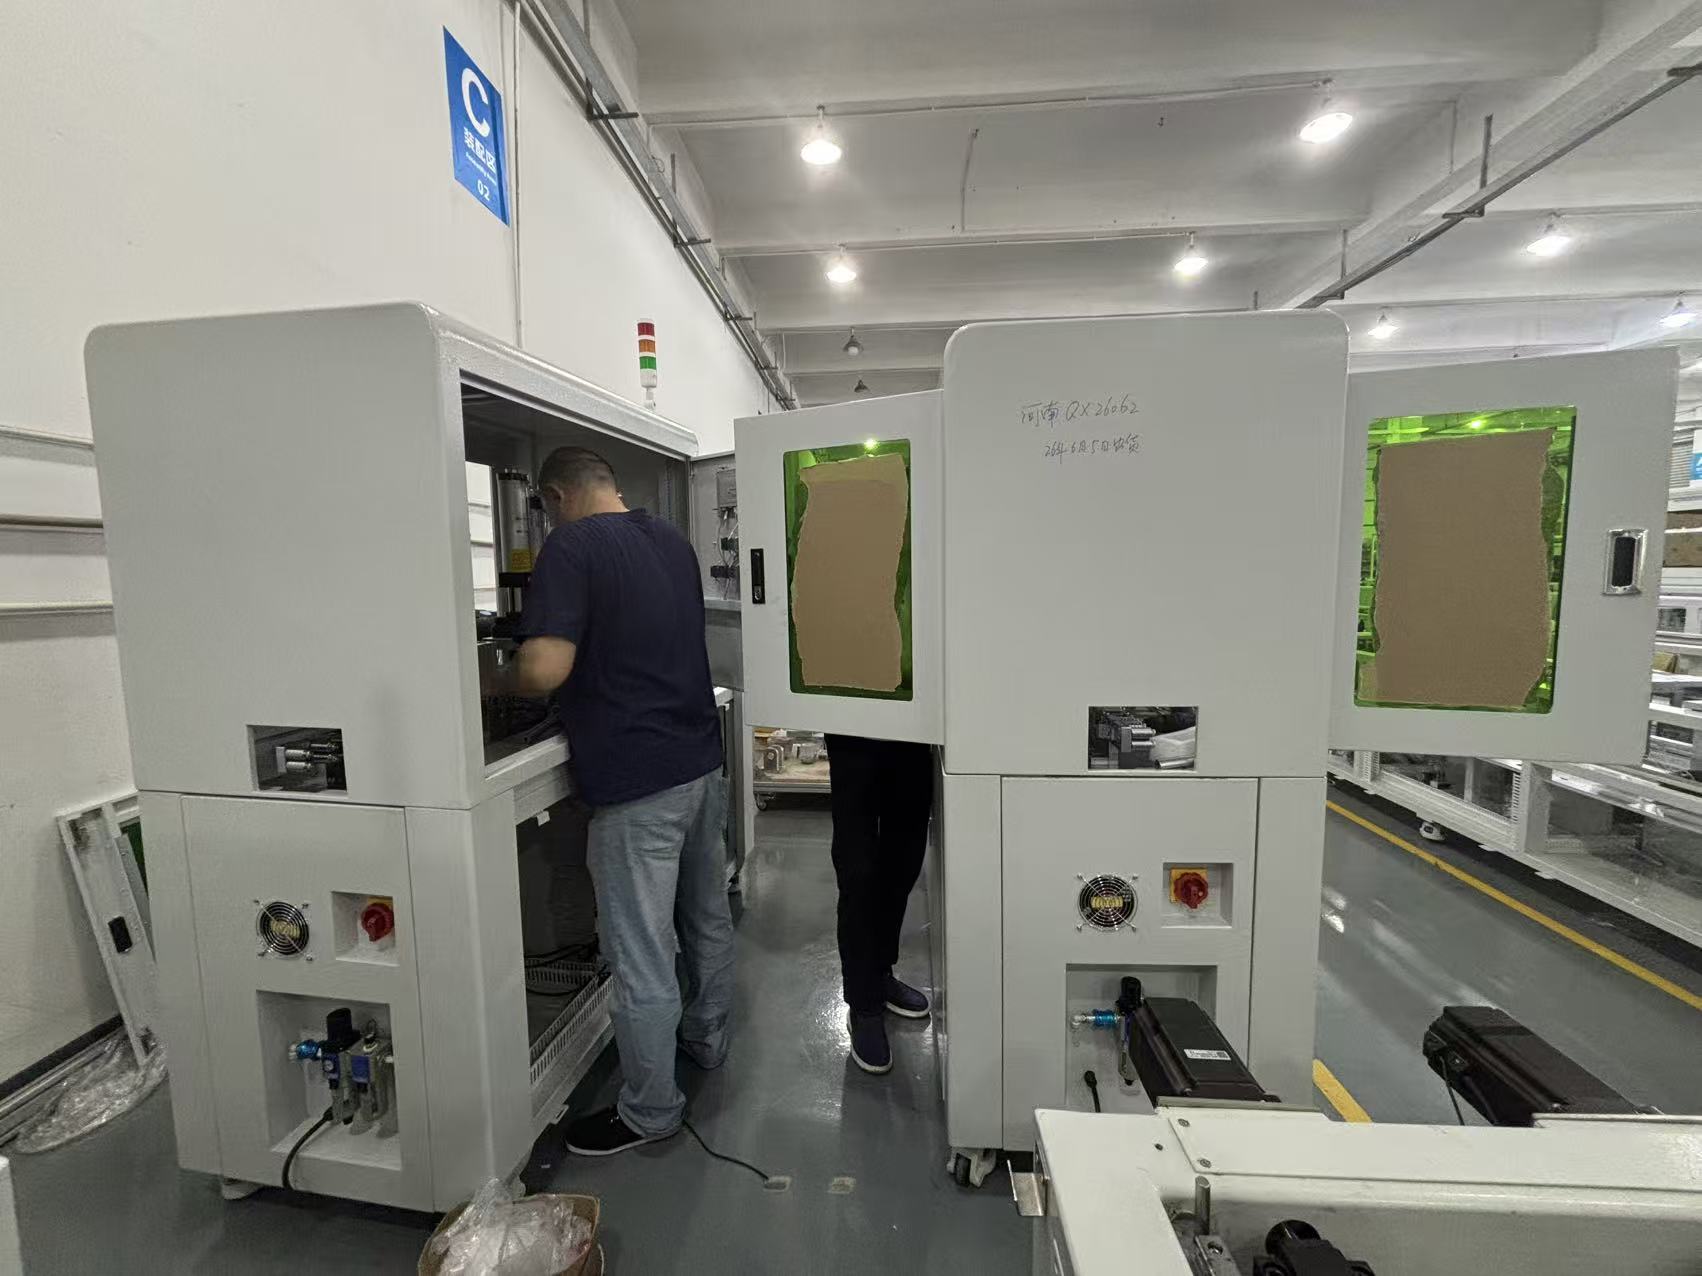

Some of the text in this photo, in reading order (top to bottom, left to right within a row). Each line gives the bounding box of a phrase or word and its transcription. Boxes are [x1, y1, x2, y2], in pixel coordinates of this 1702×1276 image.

[461, 67, 491, 138] C
[463, 126, 497, 174] 装配区
[477, 179, 491, 201] 02
